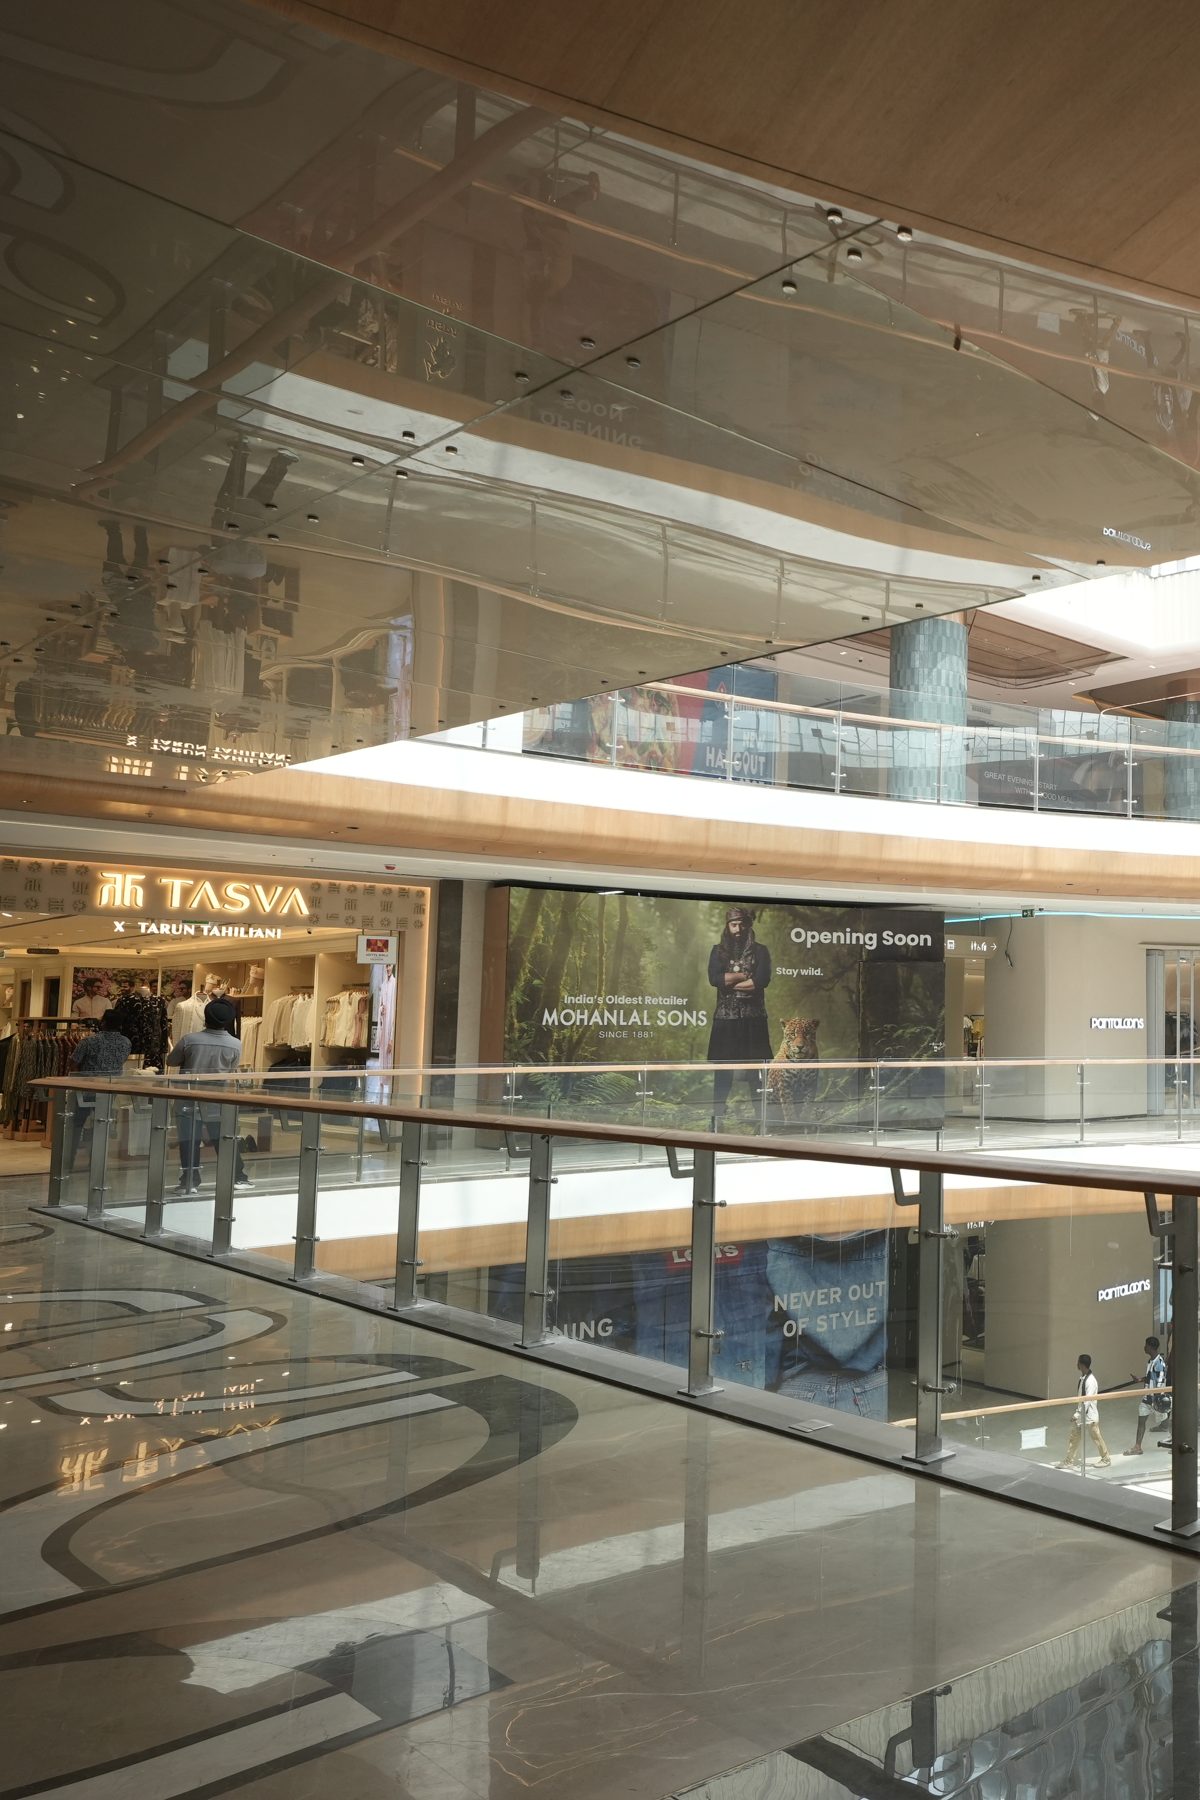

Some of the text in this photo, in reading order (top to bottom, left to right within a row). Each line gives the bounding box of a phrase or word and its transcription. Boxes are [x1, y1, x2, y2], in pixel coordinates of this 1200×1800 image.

[705, 746, 766, 777] HAGOUT
[984, 771, 1006, 781] GREAT
[160, 878, 310, 915] TASVA
[138, 922, 195, 936] TARUN
[200, 924, 282, 939] TAHILIANI
[790, 927, 932, 950] Opening Soon
[776, 967, 824, 978] Stay wild.
[564, 994, 688, 1006] India's Oldest Retailer
[541, 1008, 708, 1027] MOHANLAL SONS
[598, 1031, 629, 1039] SINCE
[774, 1280, 886, 1312] NEVER OUT
[783, 1307, 878, 1337] OF STYLE
